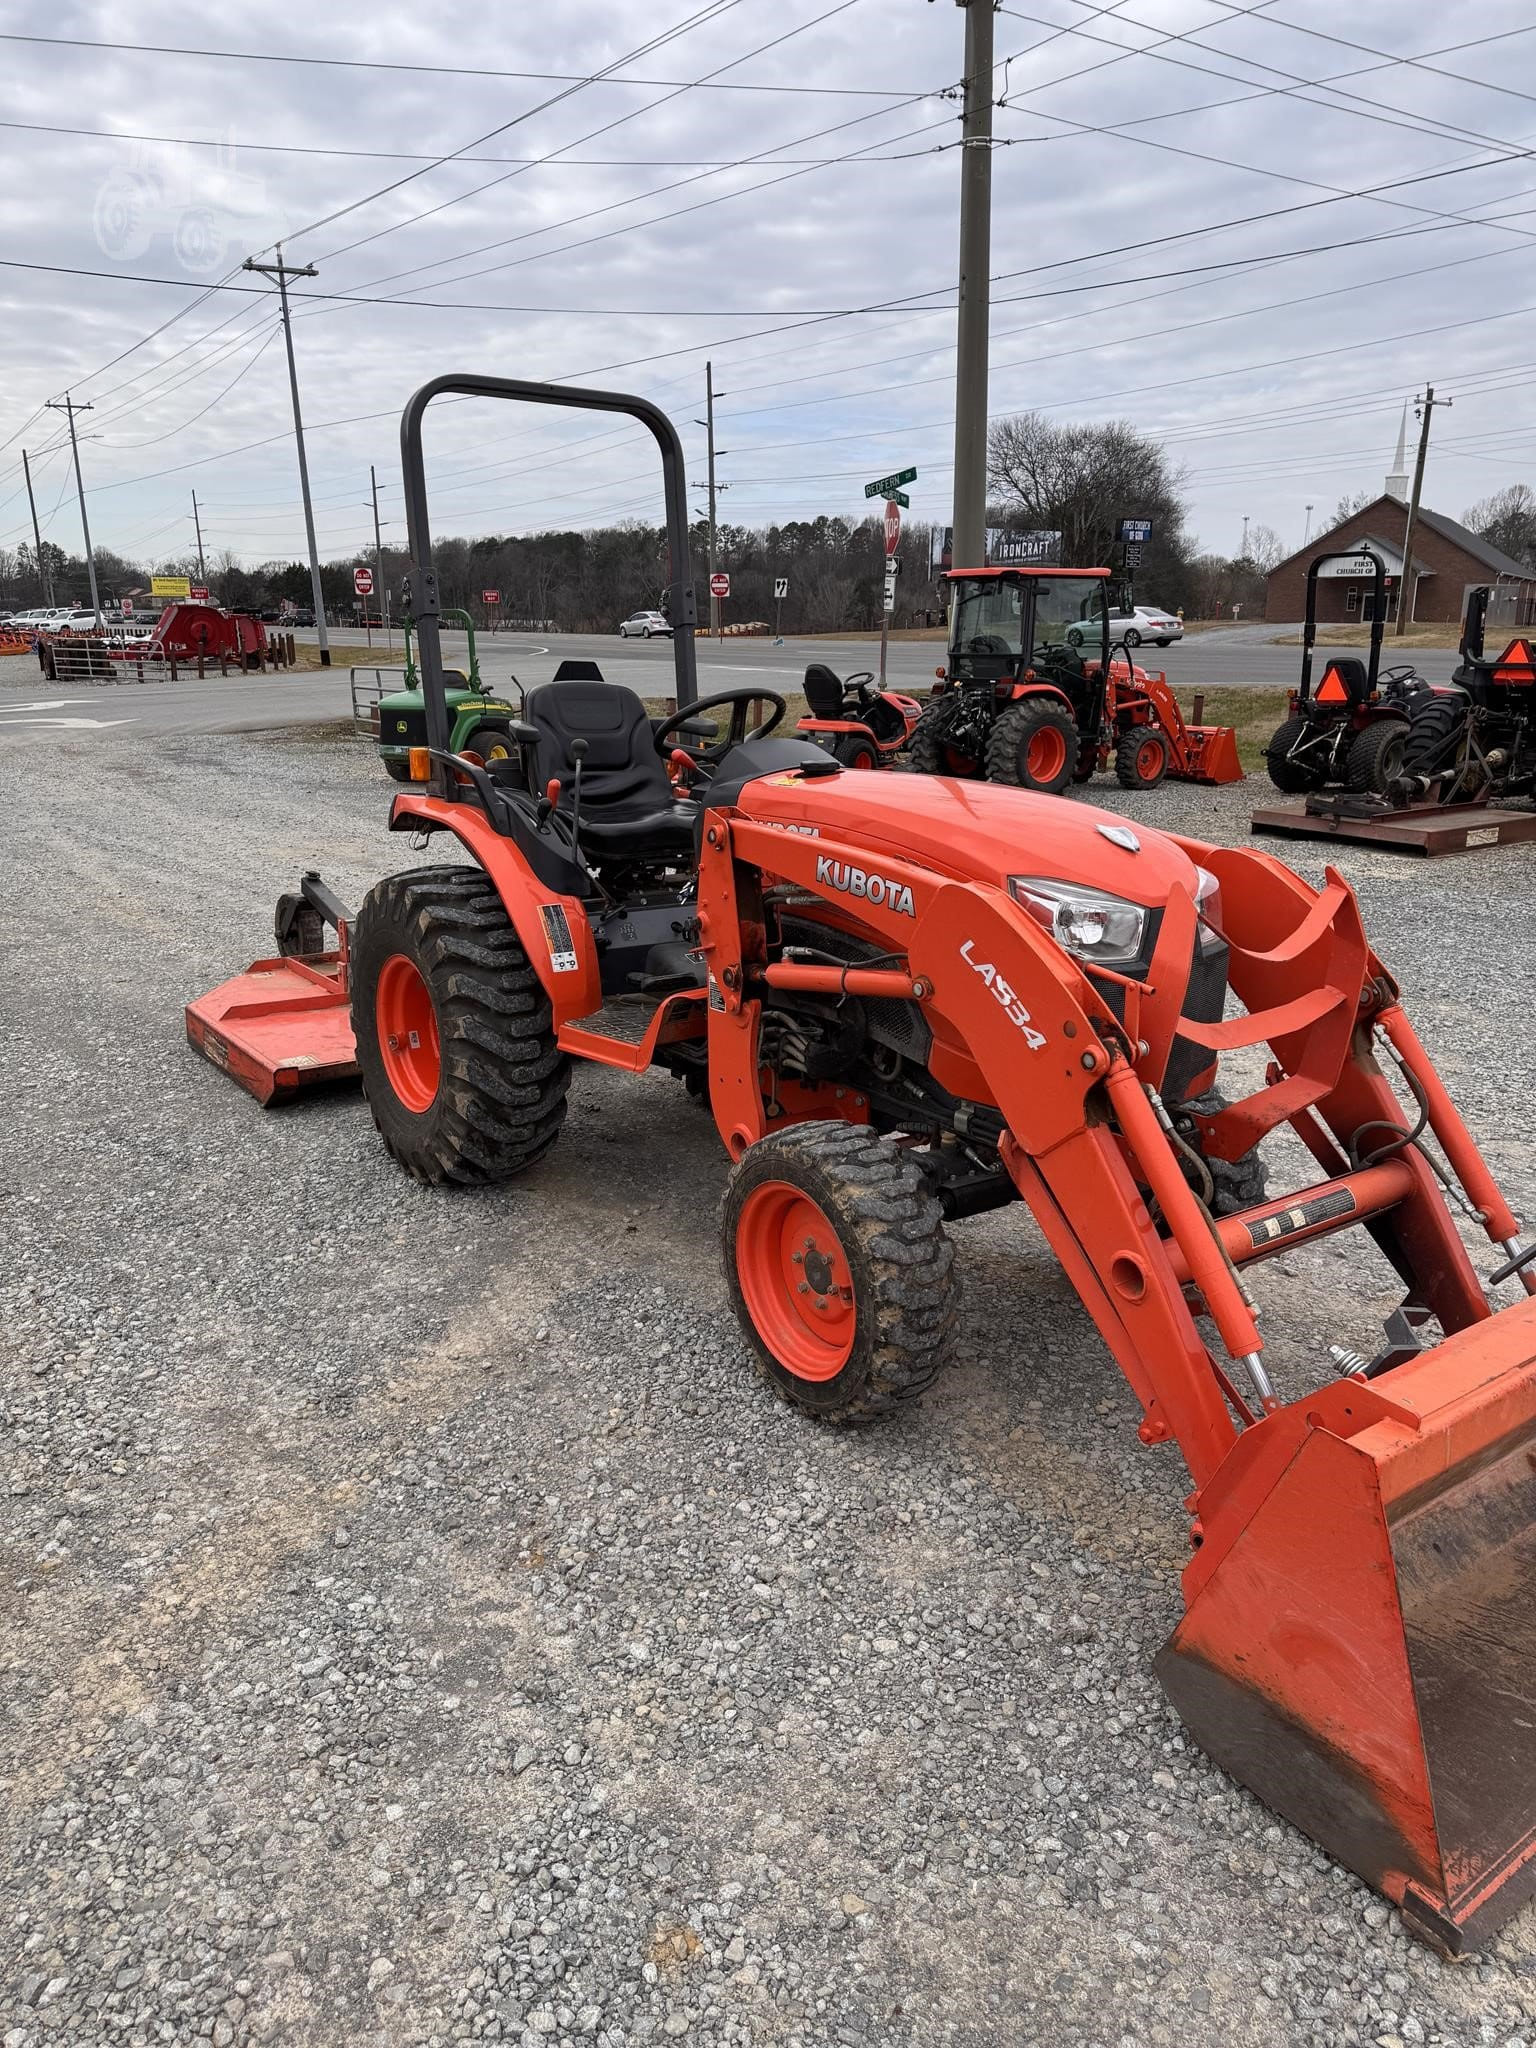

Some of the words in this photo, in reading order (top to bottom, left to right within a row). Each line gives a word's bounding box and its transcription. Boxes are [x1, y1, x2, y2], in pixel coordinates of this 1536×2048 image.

[865, 475, 900, 497] REDFERN
[884, 518, 899, 537] TOP
[1122, 520, 1135, 530] FIRST
[999, 540, 1050, 558] IRONCRAFT
[1354, 560, 1373, 568] FIRST
[754, 820, 820, 839] OTA
[815, 855, 916, 918] KUBOTA
[959, 939, 1047, 1051] LA534
